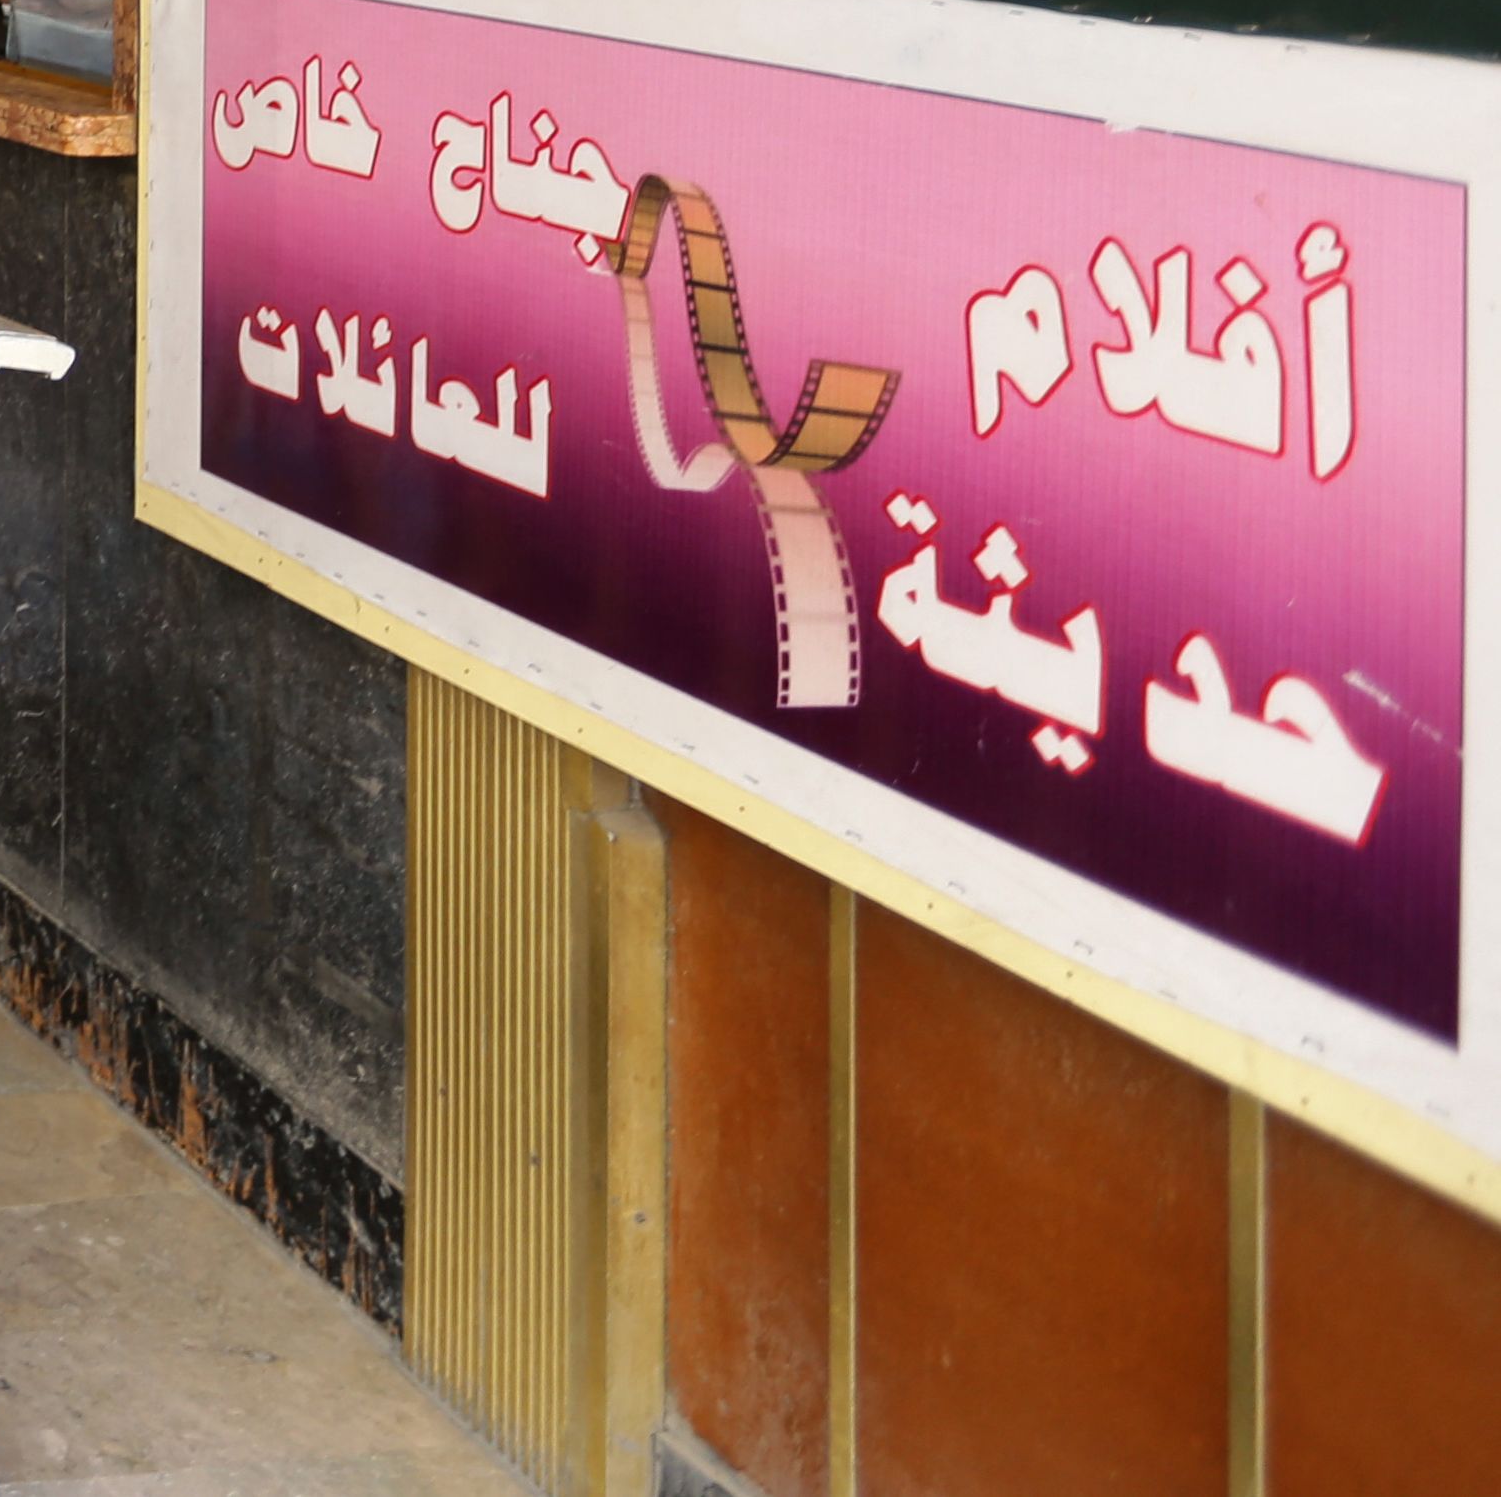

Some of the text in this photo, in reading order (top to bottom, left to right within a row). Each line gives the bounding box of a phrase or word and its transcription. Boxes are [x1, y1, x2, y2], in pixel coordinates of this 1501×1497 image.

[210, 53, 632, 270] خاص جناح
[236, 305, 553, 500] للعائلات
[965, 220, 1358, 482] أفلام
[875, 490, 1390, 849] حديثة
